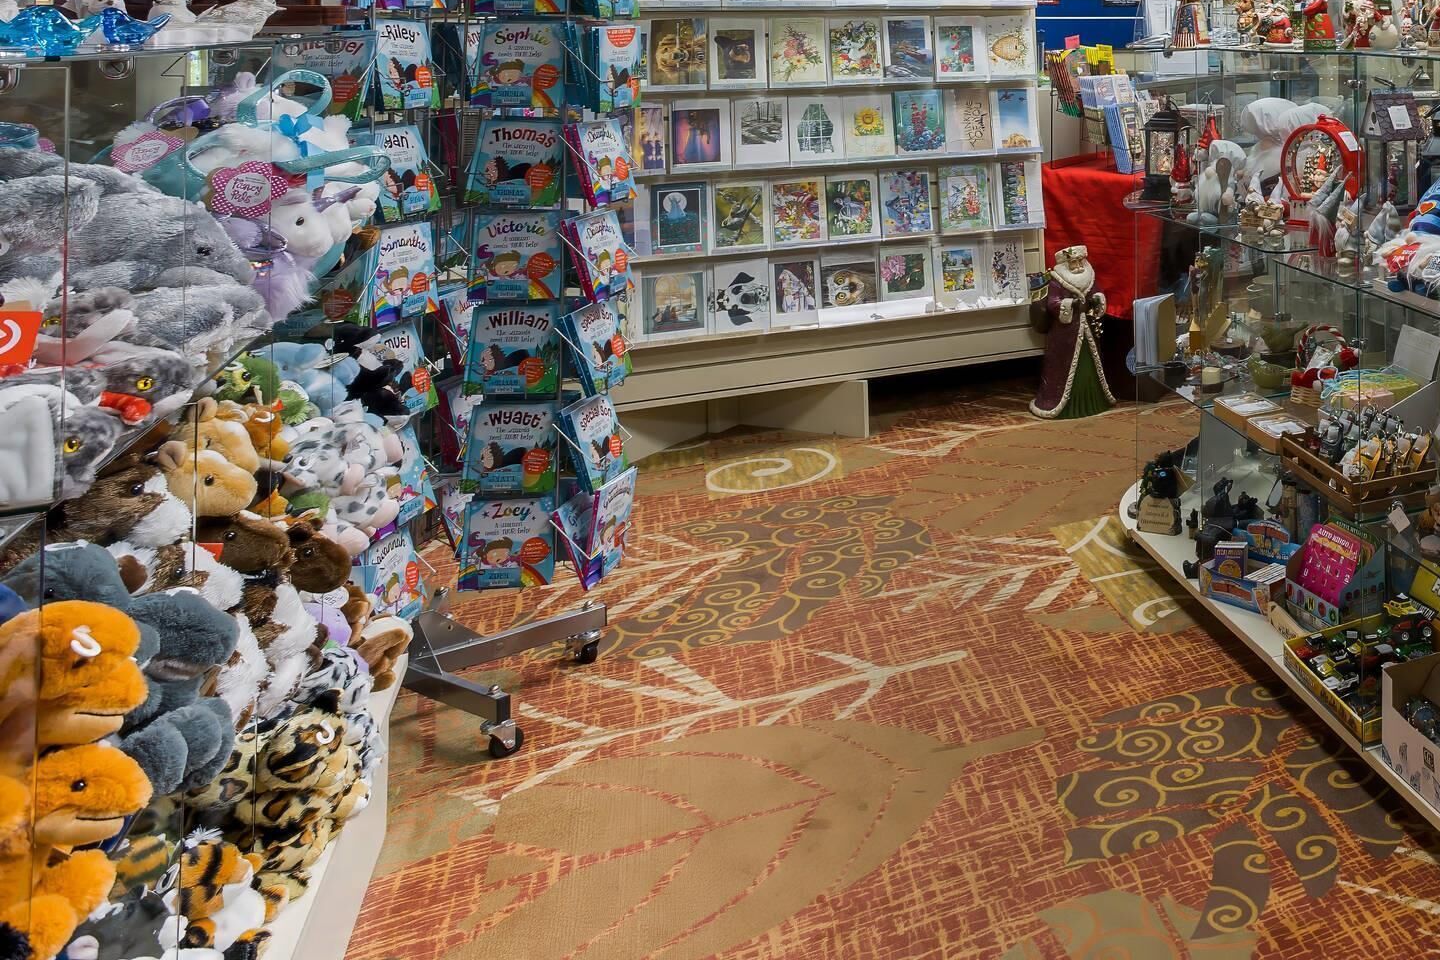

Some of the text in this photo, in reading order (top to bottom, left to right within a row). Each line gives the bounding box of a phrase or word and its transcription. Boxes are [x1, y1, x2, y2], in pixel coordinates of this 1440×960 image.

[385, 23, 417, 43] Riley
[384, 134, 411, 150] yan
[492, 128, 556, 148] Thomas
[232, 177, 263, 194] Fancy
[487, 216, 546, 238] Victoria
[488, 311, 550, 331] William
[384, 338, 411, 351] muel
[488, 410, 542, 429] Wyatt
[492, 503, 532, 521] Zoey
